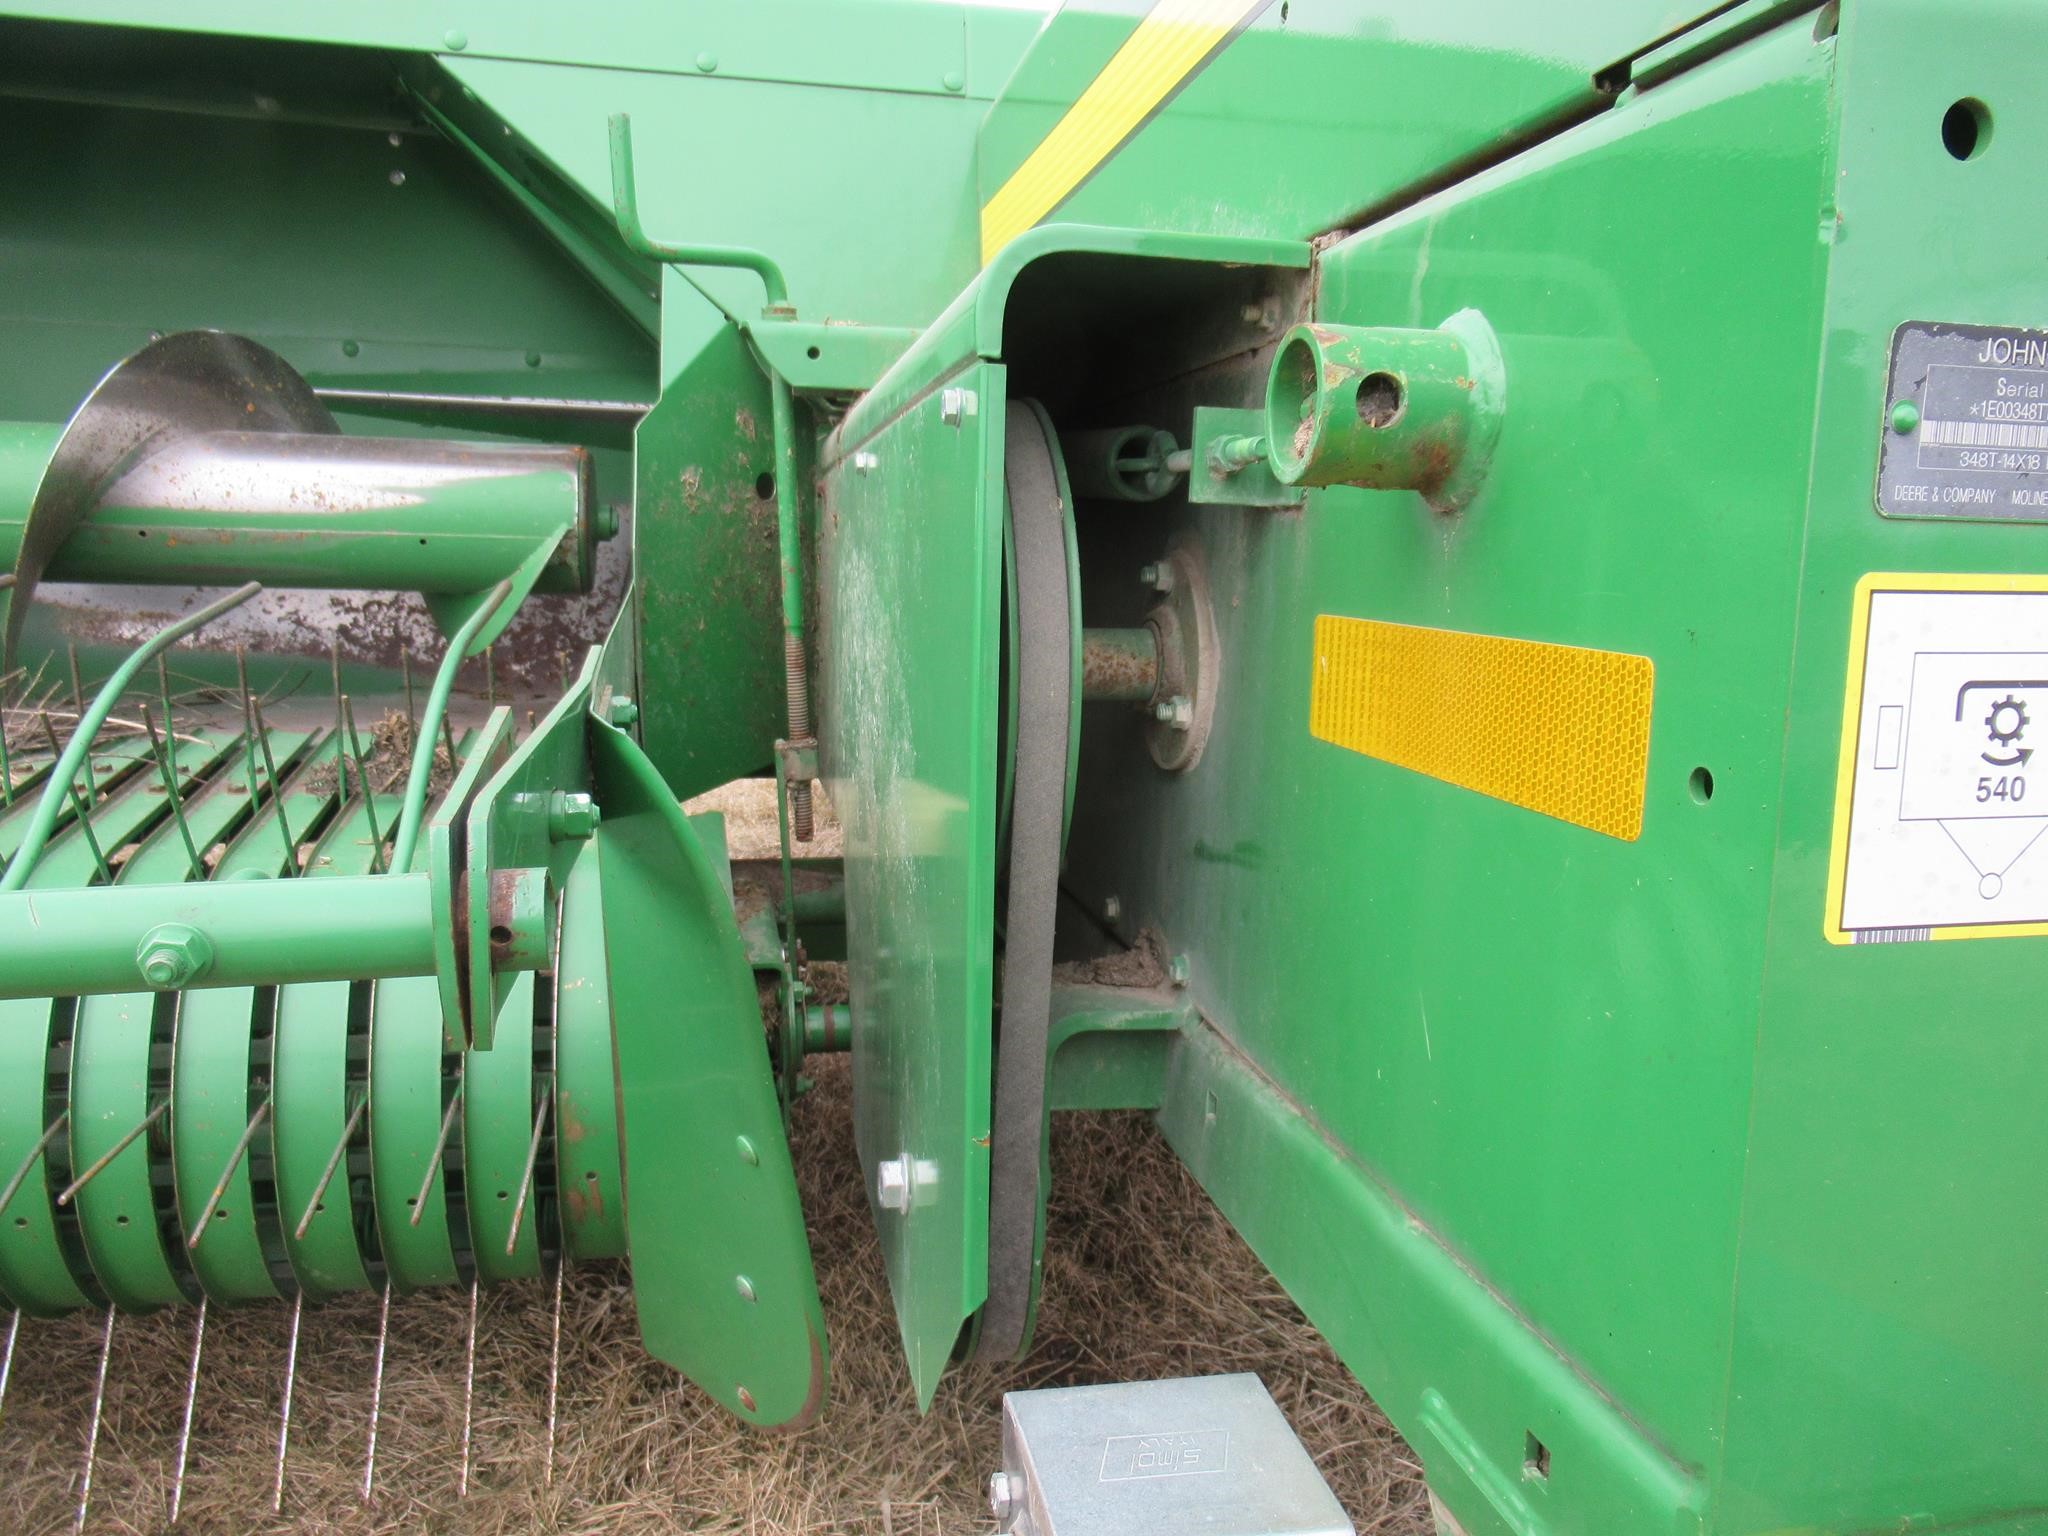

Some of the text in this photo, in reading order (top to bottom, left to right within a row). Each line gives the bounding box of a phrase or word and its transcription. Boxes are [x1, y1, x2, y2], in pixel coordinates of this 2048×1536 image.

[1979, 337, 2047, 366] JOHN
[1996, 376, 2044, 398] Serial
[1968, 400, 2048, 420] 1E00348T
[1960, 451, 2041, 470] 348T-14X18
[1894, 485, 1929, 502] DEERE
[1932, 487, 1939, 503] &
[1943, 487, 1997, 504] COMPANY
[1975, 775, 2027, 803] 540
